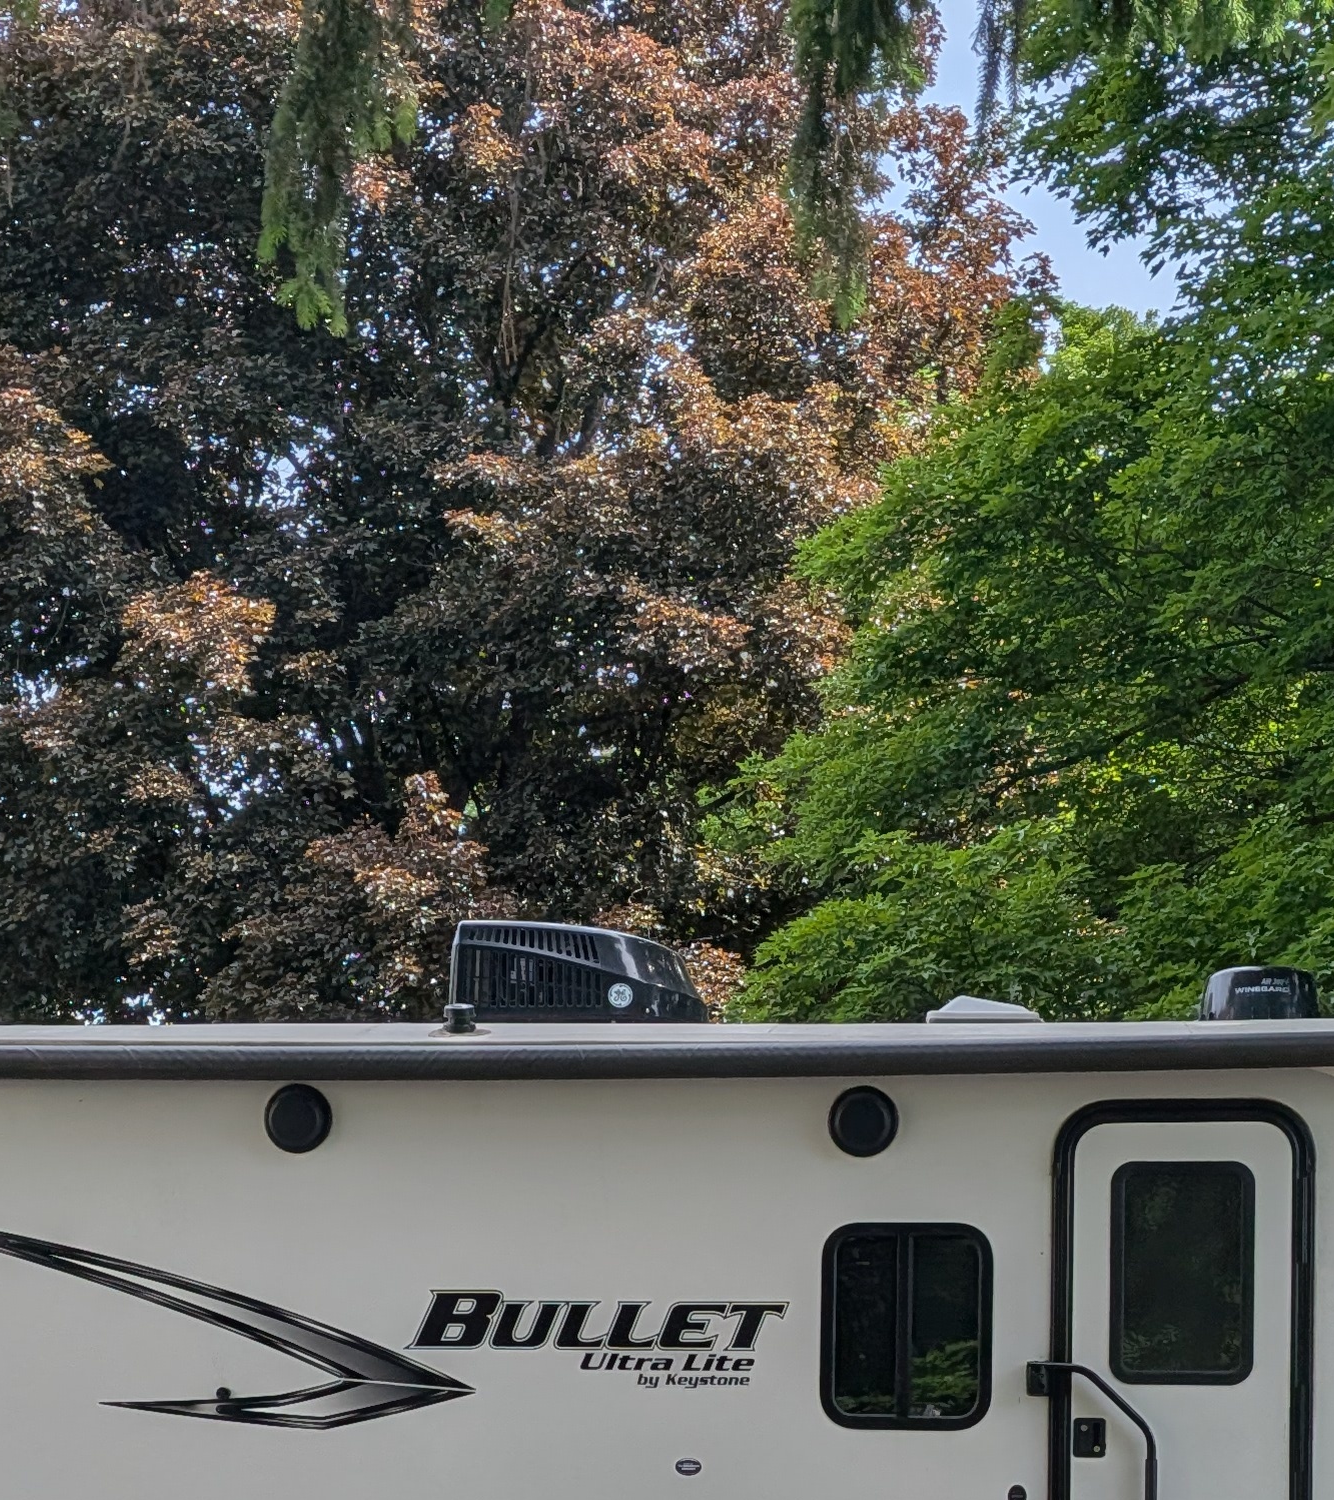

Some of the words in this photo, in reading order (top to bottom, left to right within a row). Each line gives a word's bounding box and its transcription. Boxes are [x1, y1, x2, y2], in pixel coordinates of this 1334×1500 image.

[403, 1290, 790, 1351] BULLET
[580, 1352, 673, 1371] Ultra
[681, 1353, 755, 1372] Lite
[637, 1373, 660, 1388] by
[665, 1373, 751, 1389] Keystone
